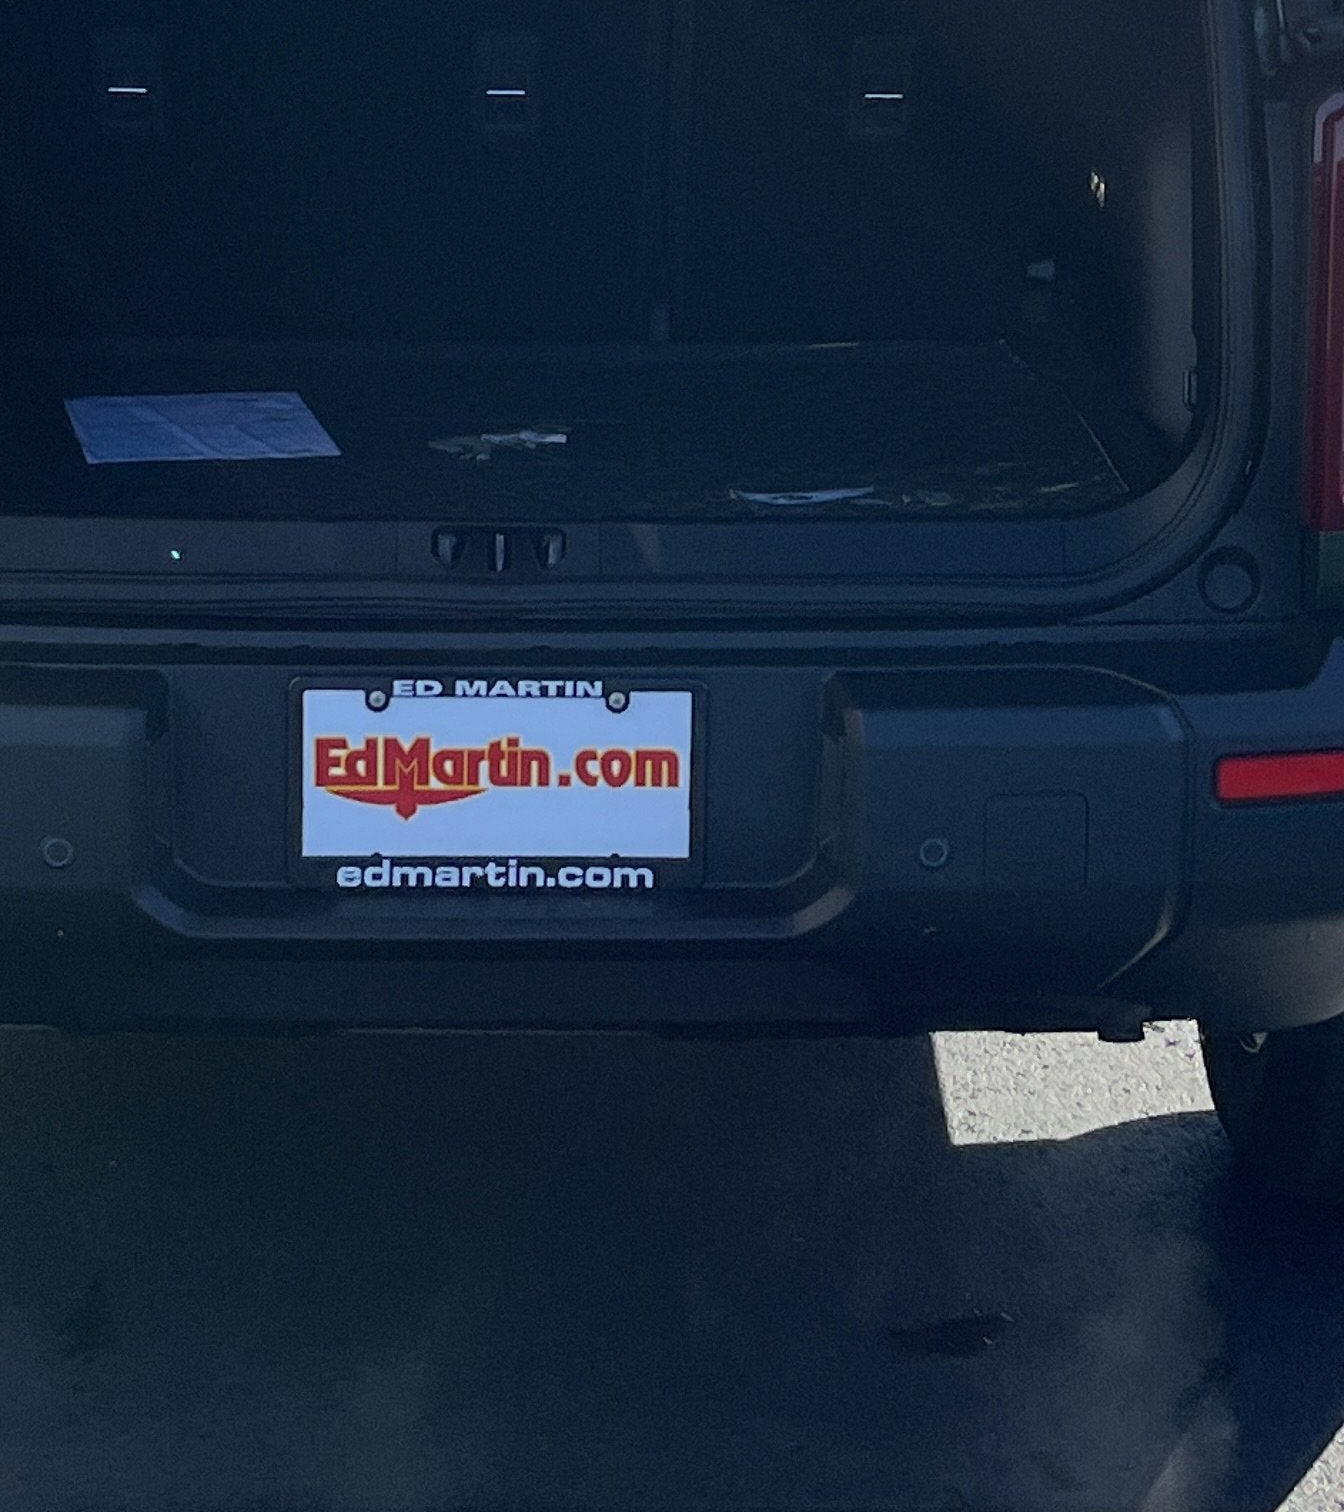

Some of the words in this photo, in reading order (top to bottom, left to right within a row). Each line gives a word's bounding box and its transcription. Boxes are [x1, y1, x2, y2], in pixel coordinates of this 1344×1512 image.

[392, 679, 443, 698] ED
[455, 679, 604, 698] MARTIN
[336, 858, 655, 888] edmartin.com
